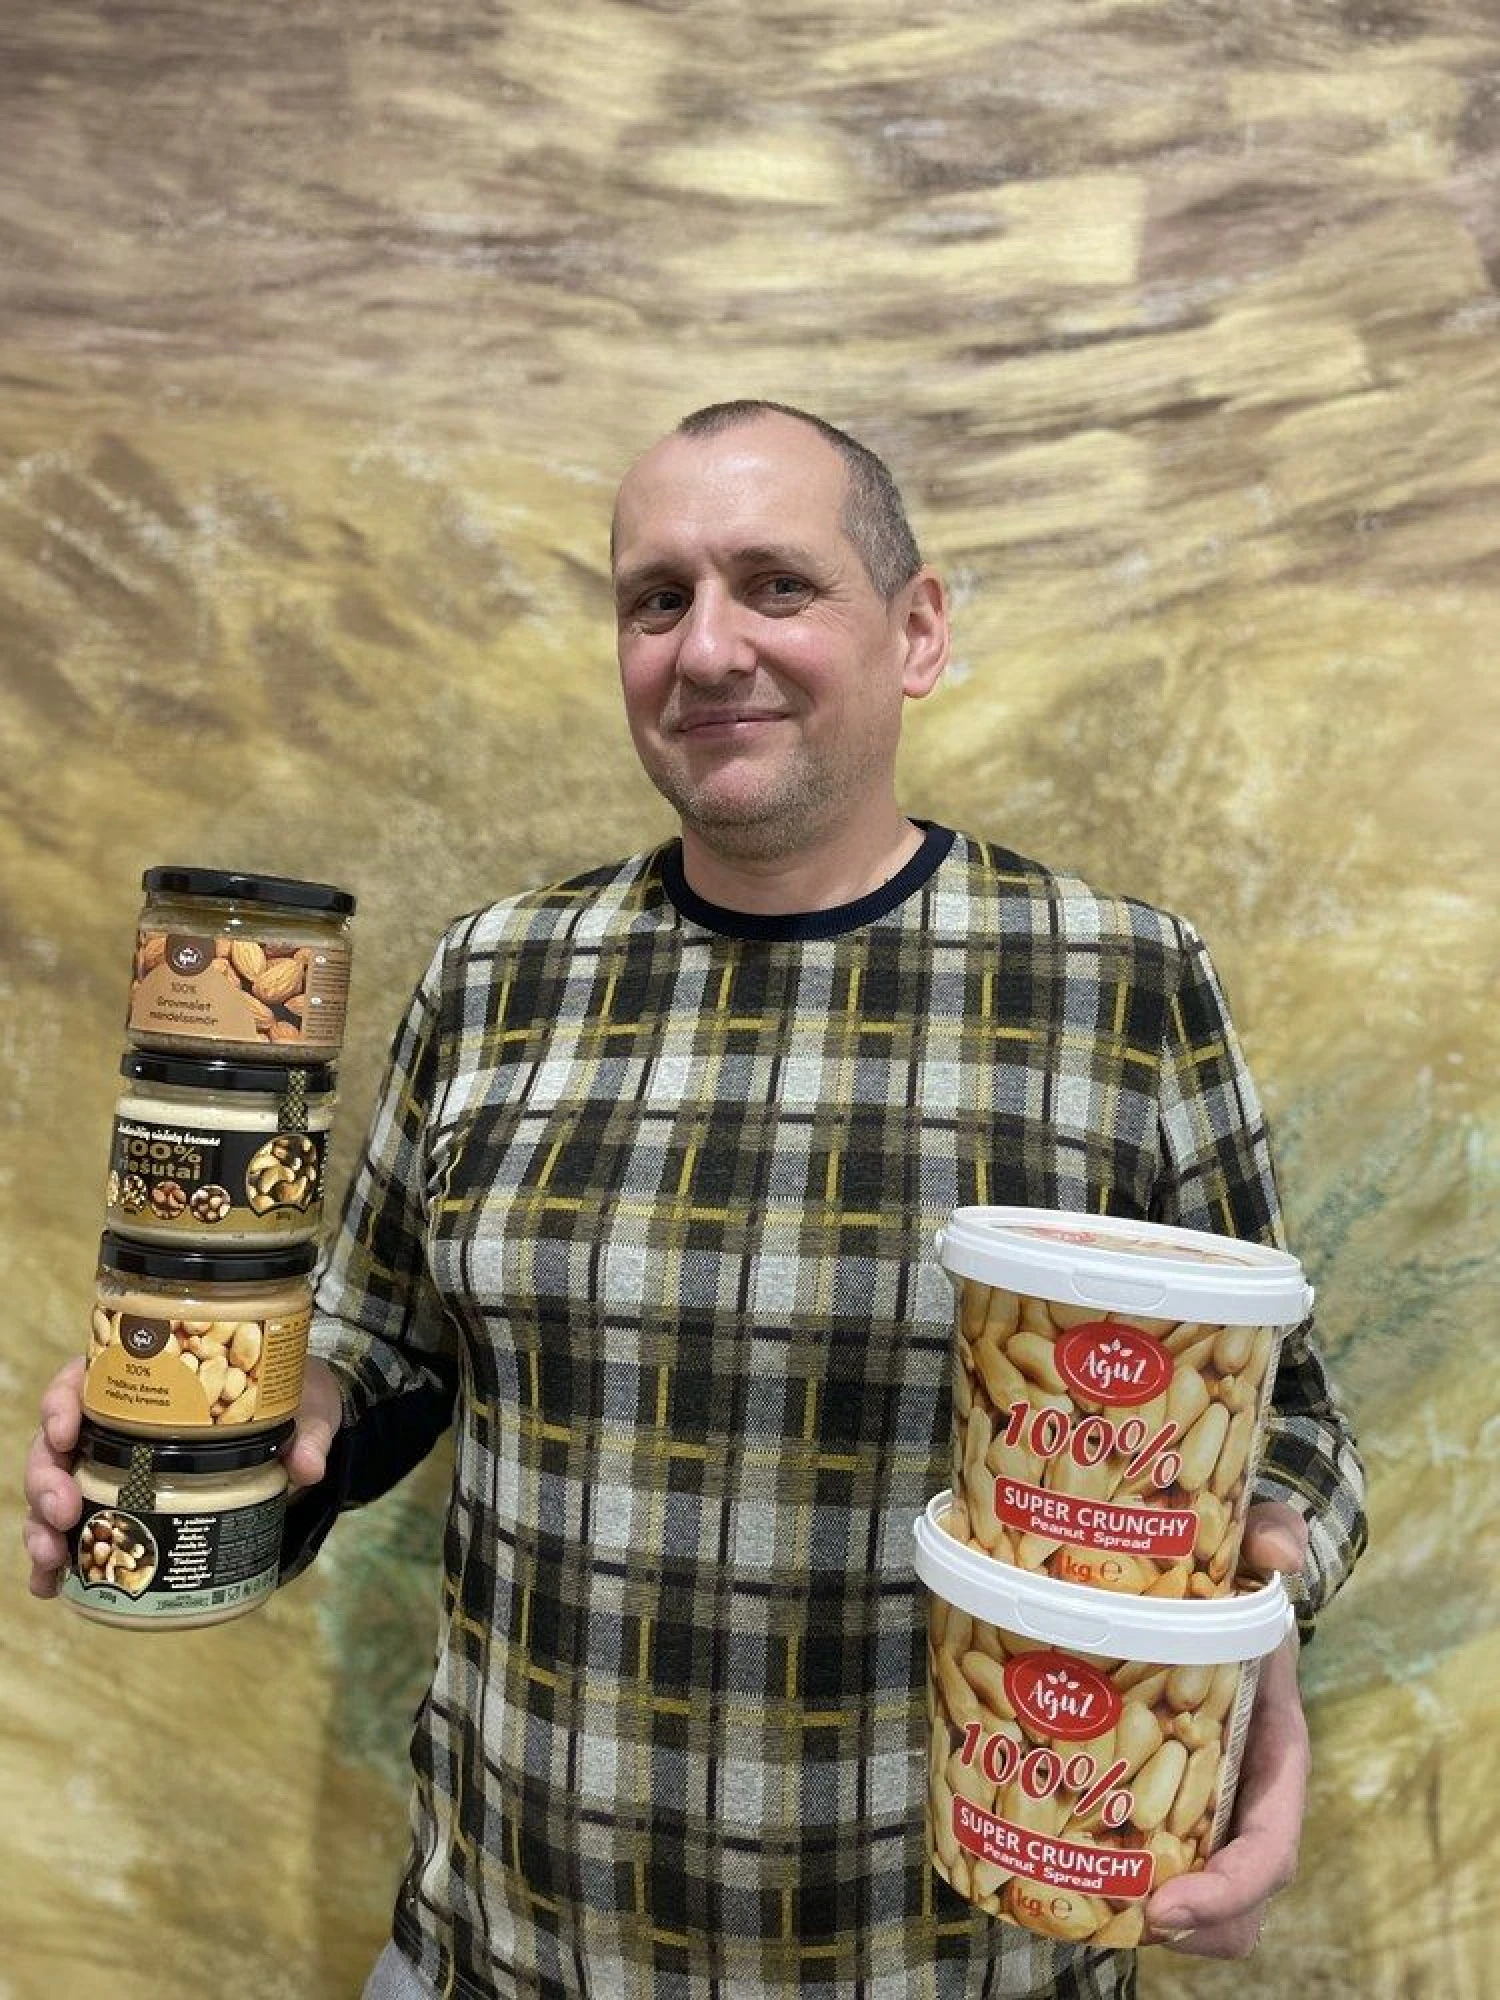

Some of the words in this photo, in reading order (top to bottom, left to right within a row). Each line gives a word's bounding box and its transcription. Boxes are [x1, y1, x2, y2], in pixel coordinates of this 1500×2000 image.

[122, 1138, 203, 1162] 100%
[126, 1363, 151, 1377] 100%
[1003, 1401, 1182, 1489] 100%
[1004, 1486, 1071, 1522] SUPER
[1076, 1506, 1190, 1538] CRUNCHY
[1031, 1515, 1085, 1542] Peanut
[1093, 1531, 1152, 1551] Spread
[960, 1721, 1135, 1828] 100%
[960, 1806, 1020, 1854] SUPER
[1026, 1840, 1145, 1878] CRUNCHY
[983, 1841, 1036, 1876] Peanut
[1043, 1867, 1104, 1890] Spread
